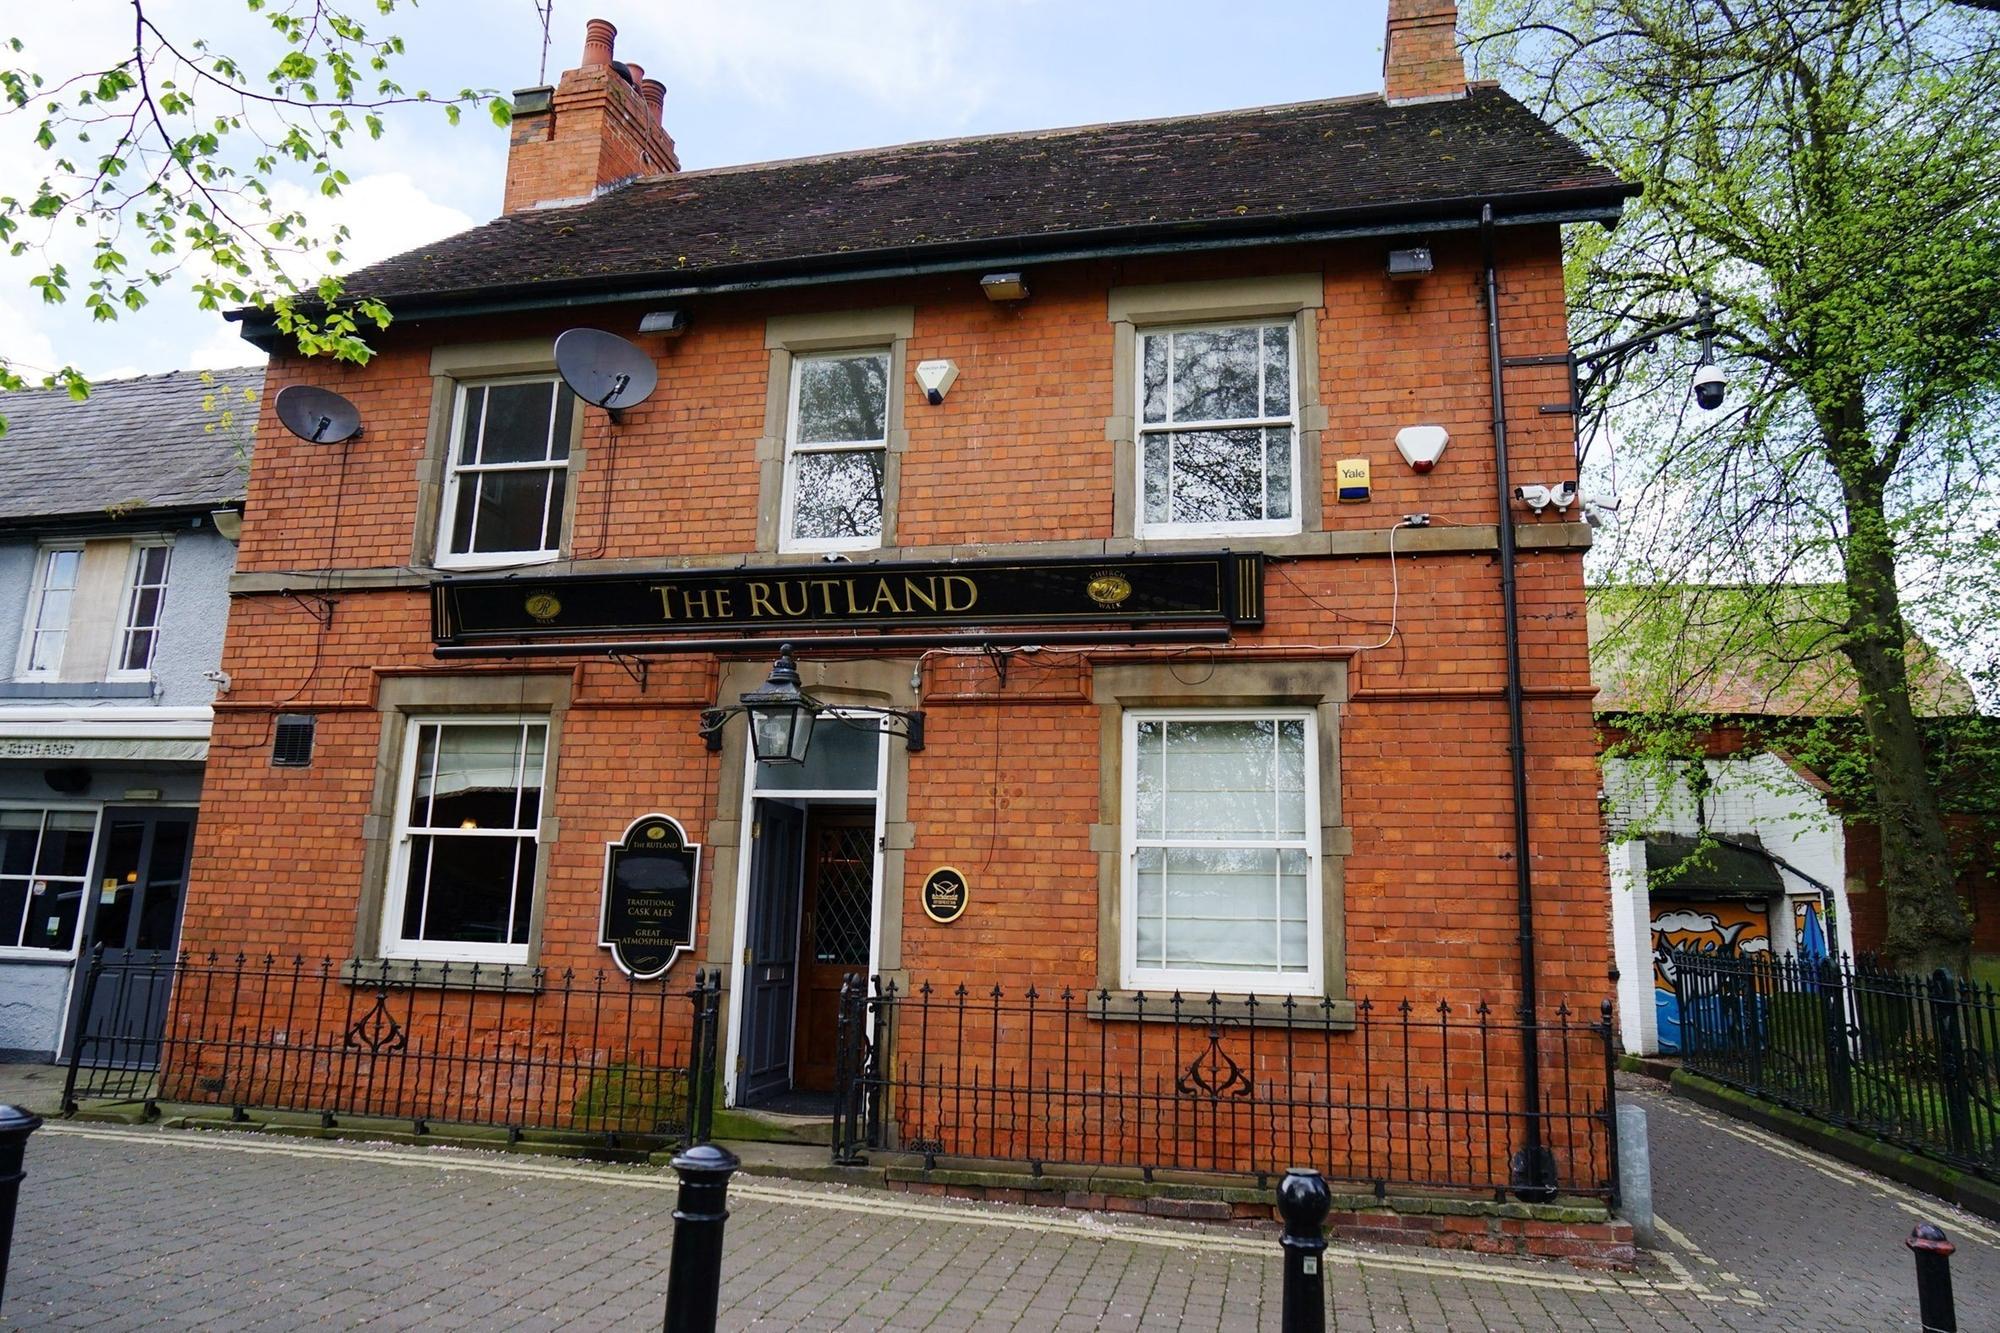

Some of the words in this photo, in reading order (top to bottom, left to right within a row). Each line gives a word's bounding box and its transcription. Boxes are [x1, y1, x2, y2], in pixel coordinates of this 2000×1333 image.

[1342, 469, 1365, 479] Yale
[1089, 569, 1126, 580] CHURCH
[650, 586, 734, 619] THE
[745, 575, 978, 617] RUTLAND
[1098, 602, 1122, 610] WALK
[646, 841, 678, 849] RUTLAND
[627, 898, 676, 907] TRADITIONAL
[627, 907, 650, 916] CASK
[653, 908, 673, 917] ALES
[635, 928, 661, 937] GREAT
[621, 937, 674, 946] ATMOSPHERE
